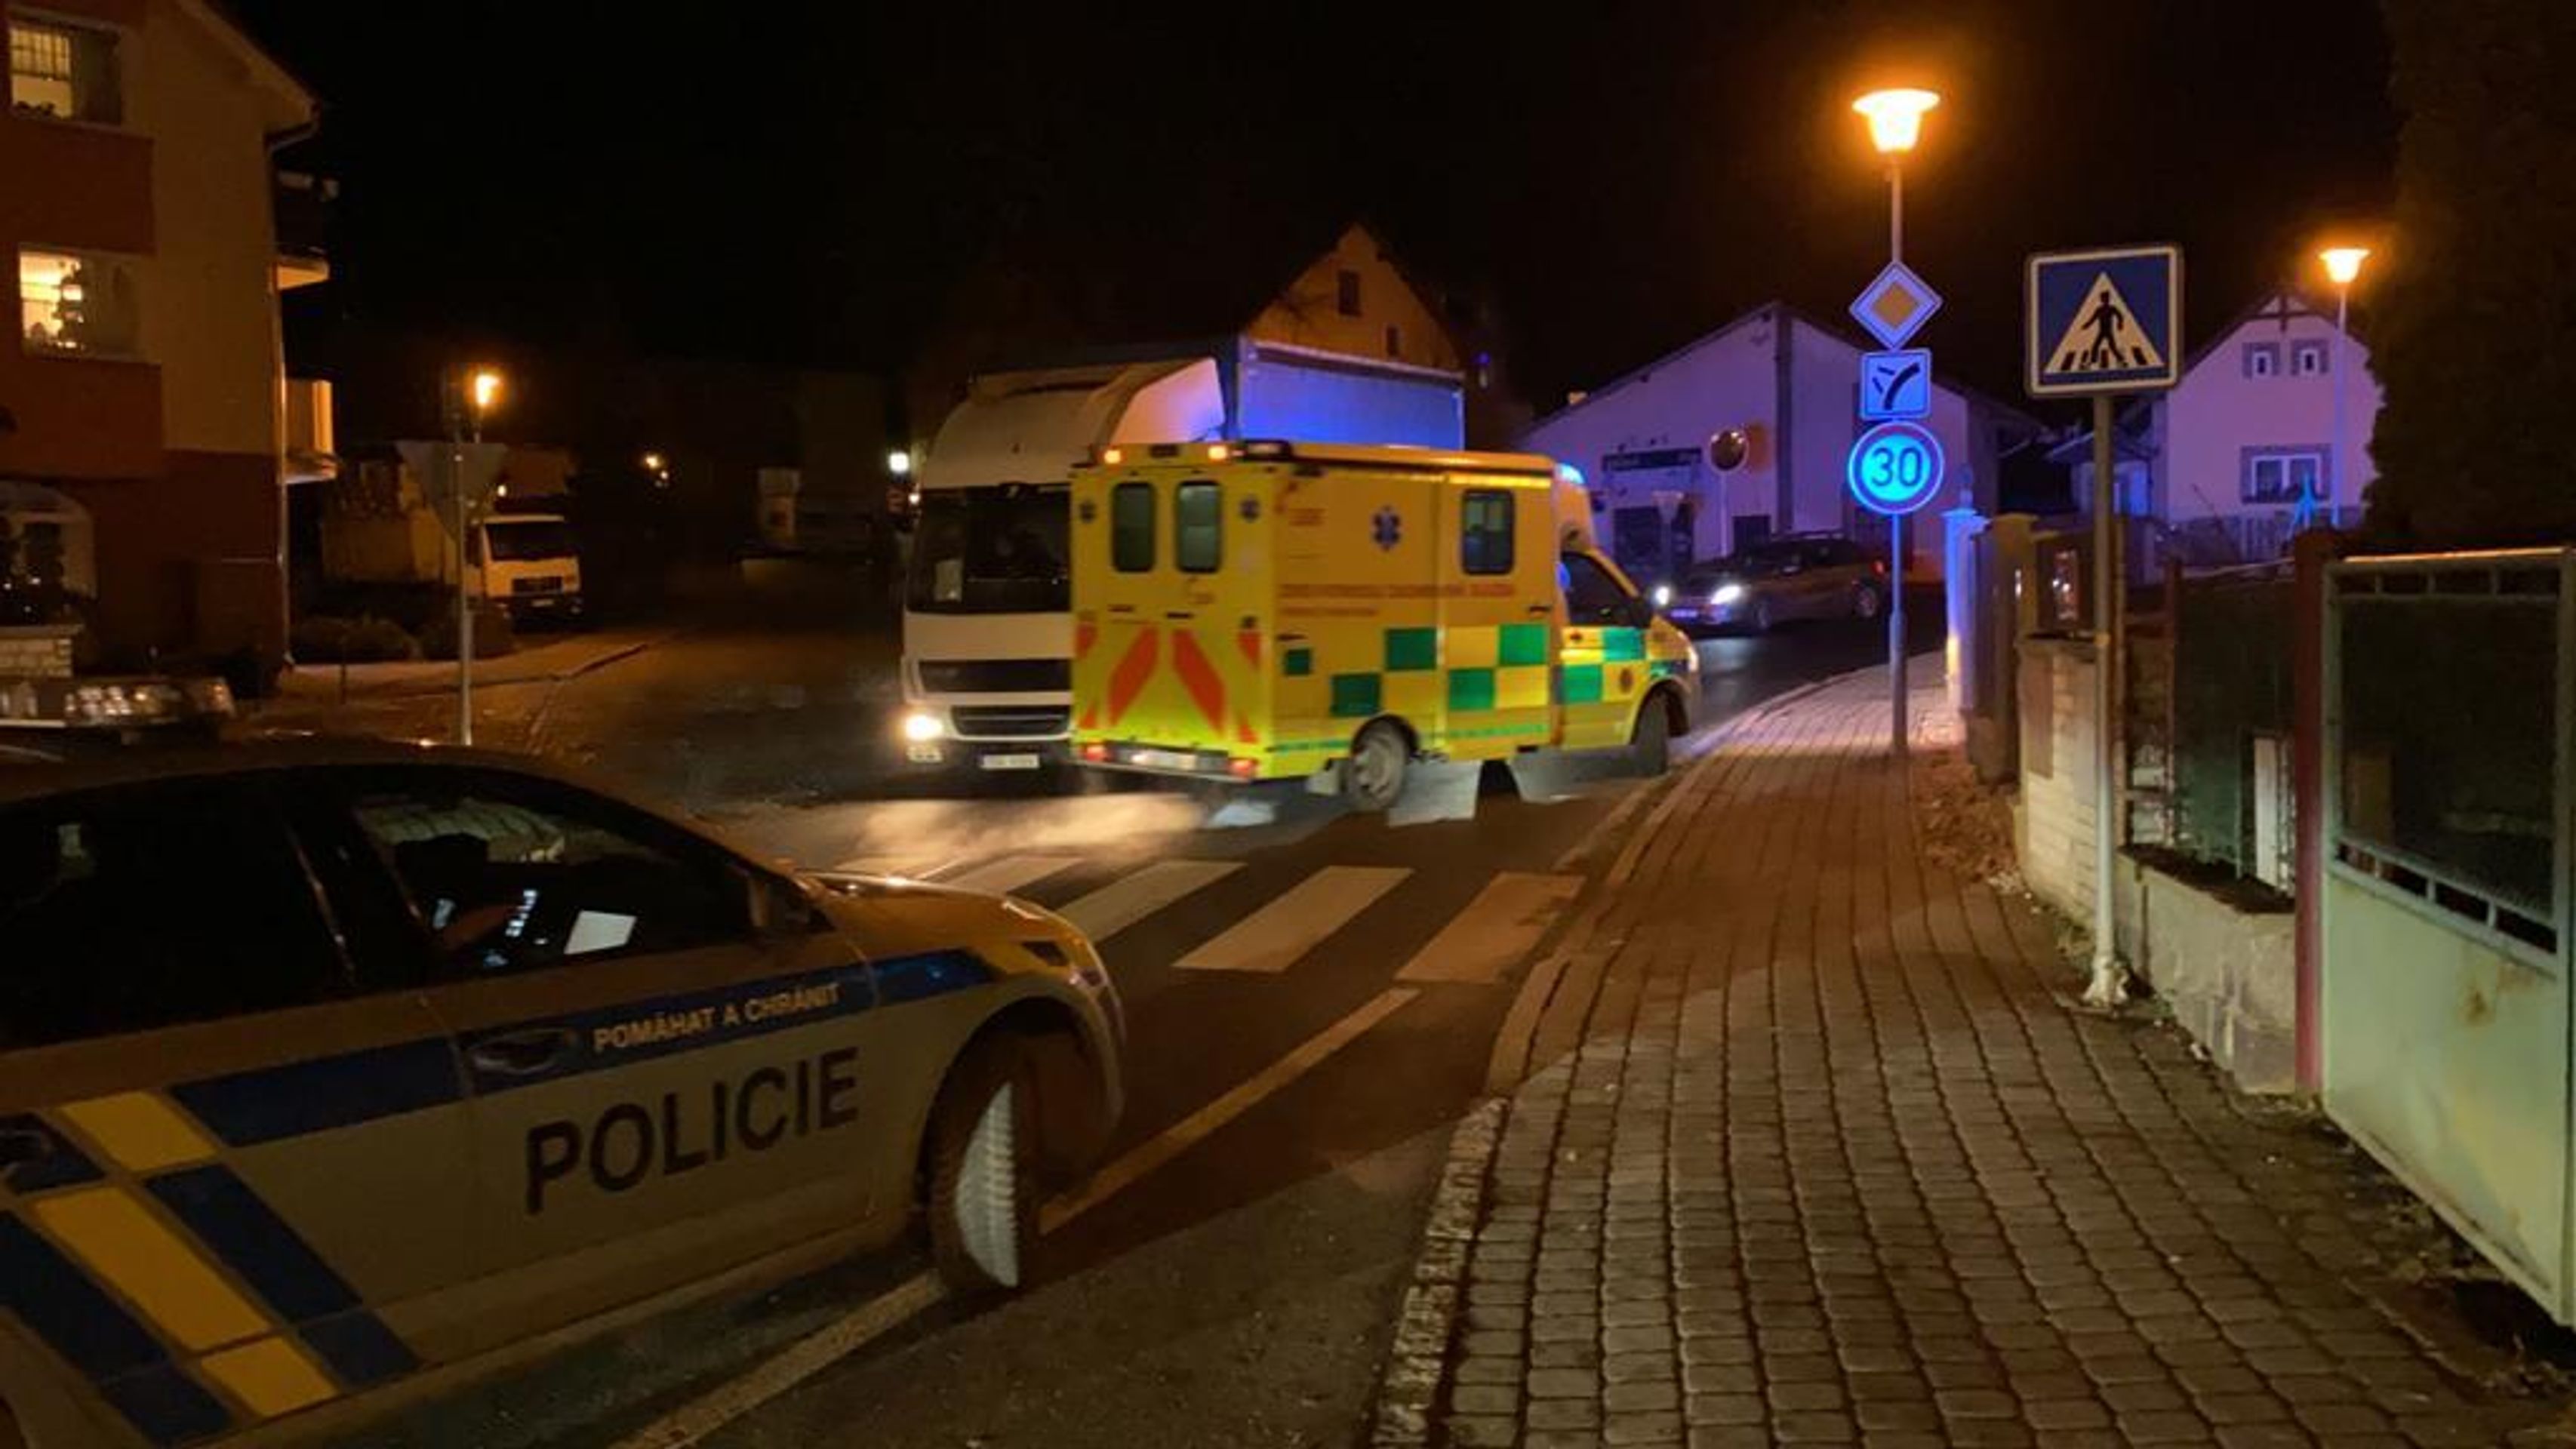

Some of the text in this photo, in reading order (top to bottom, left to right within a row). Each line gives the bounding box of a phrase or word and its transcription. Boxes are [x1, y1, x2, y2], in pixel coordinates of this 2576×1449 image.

[1870, 446, 1923, 488] 30
[592, 982, 841, 1053] POMÁHAT A CHRÁNIT
[525, 1046, 860, 1215] POLICIE
